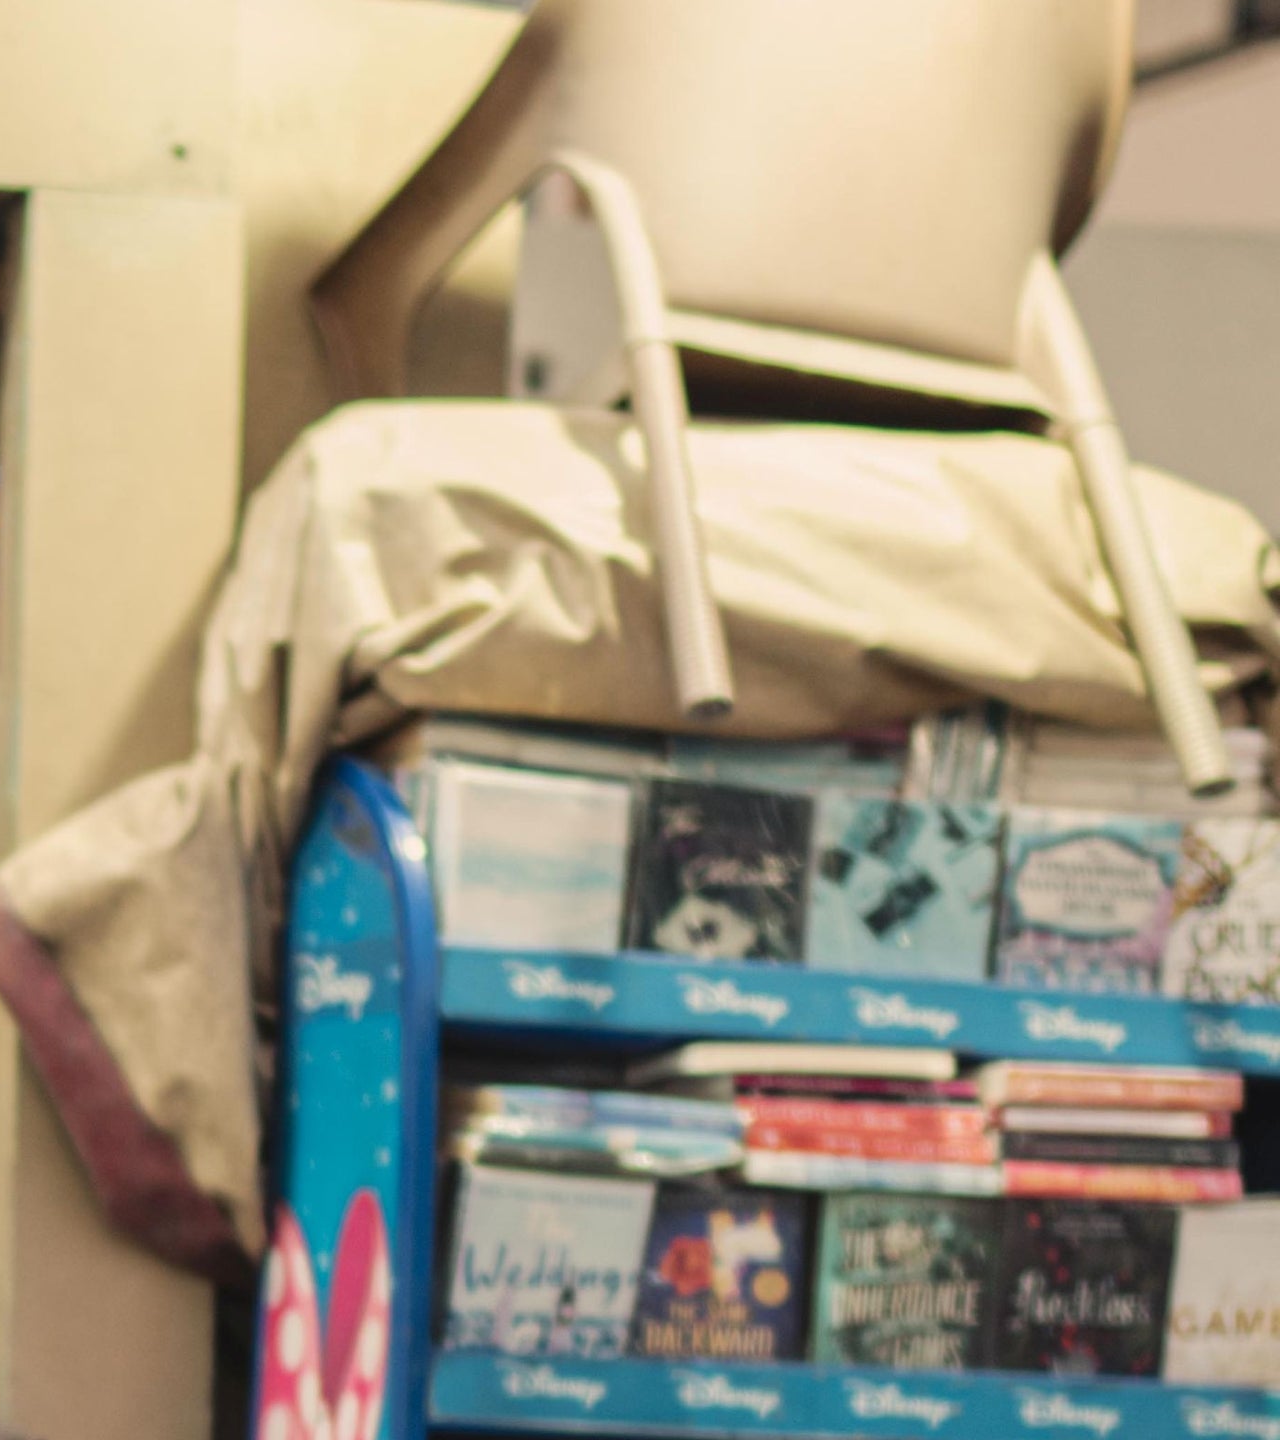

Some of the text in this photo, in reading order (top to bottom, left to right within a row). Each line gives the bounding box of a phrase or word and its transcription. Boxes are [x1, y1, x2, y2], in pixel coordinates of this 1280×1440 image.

[503, 960, 615, 1012] Disney
[676, 972, 790, 1027] Disney
[849, 986, 960, 1040] Disney
[1017, 1000, 1127, 1054] Disney
[494, 1362, 607, 1410] Disney
[670, 1368, 781, 1419] Disney
[843, 1378, 955, 1429] Disney
[1013, 1386, 1120, 1435] Disney
